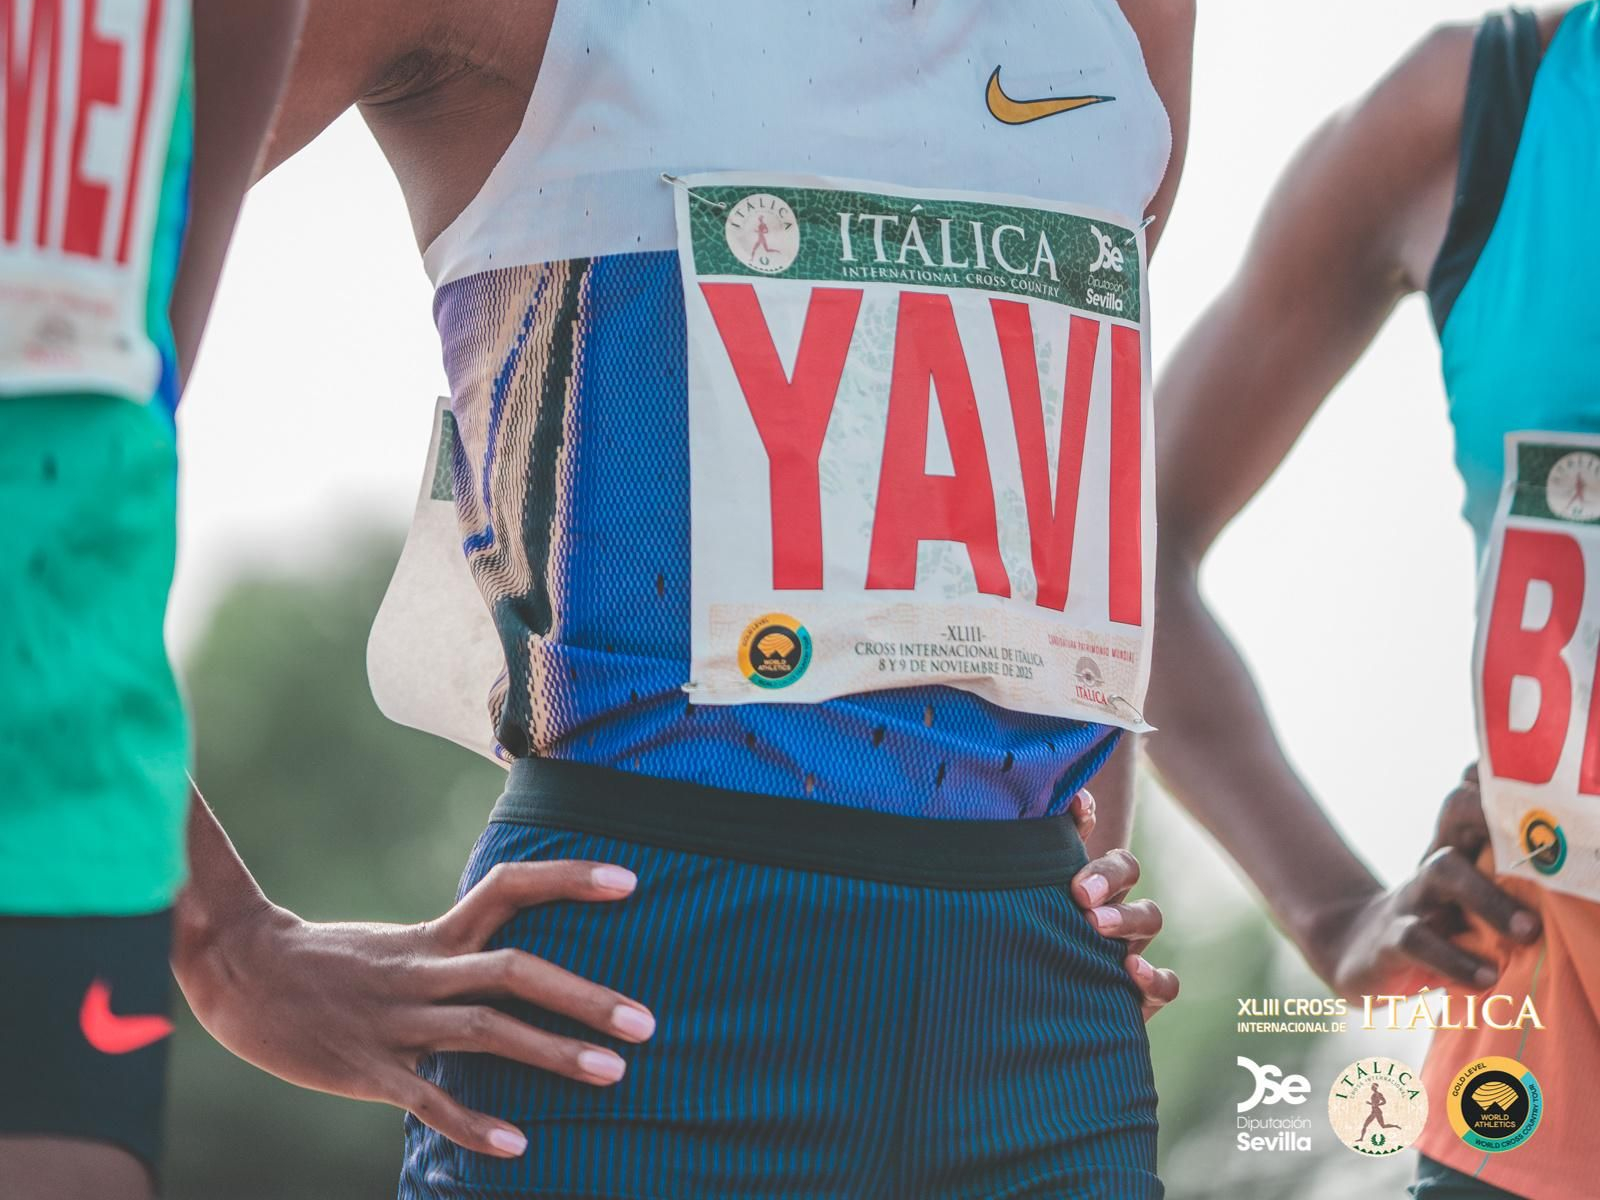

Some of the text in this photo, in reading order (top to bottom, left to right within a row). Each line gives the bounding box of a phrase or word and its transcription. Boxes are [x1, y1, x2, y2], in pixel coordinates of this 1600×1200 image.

[836, 203, 1061, 282] ITÁLICA
[842, 266, 1060, 298] INTERNATIONAL CROSS COUNTRY
[1085, 287, 1123, 312] Sevilla
[698, 282, 1142, 627] YAVI
[855, 641, 897, 656] CROSS
[900, 643, 999, 660] INTERNACIONAL
[1001, 647, 1014, 662] DE
[878, 658, 1034, 680] 8 Y 9 DE NOVIEMBRE DE 2025
